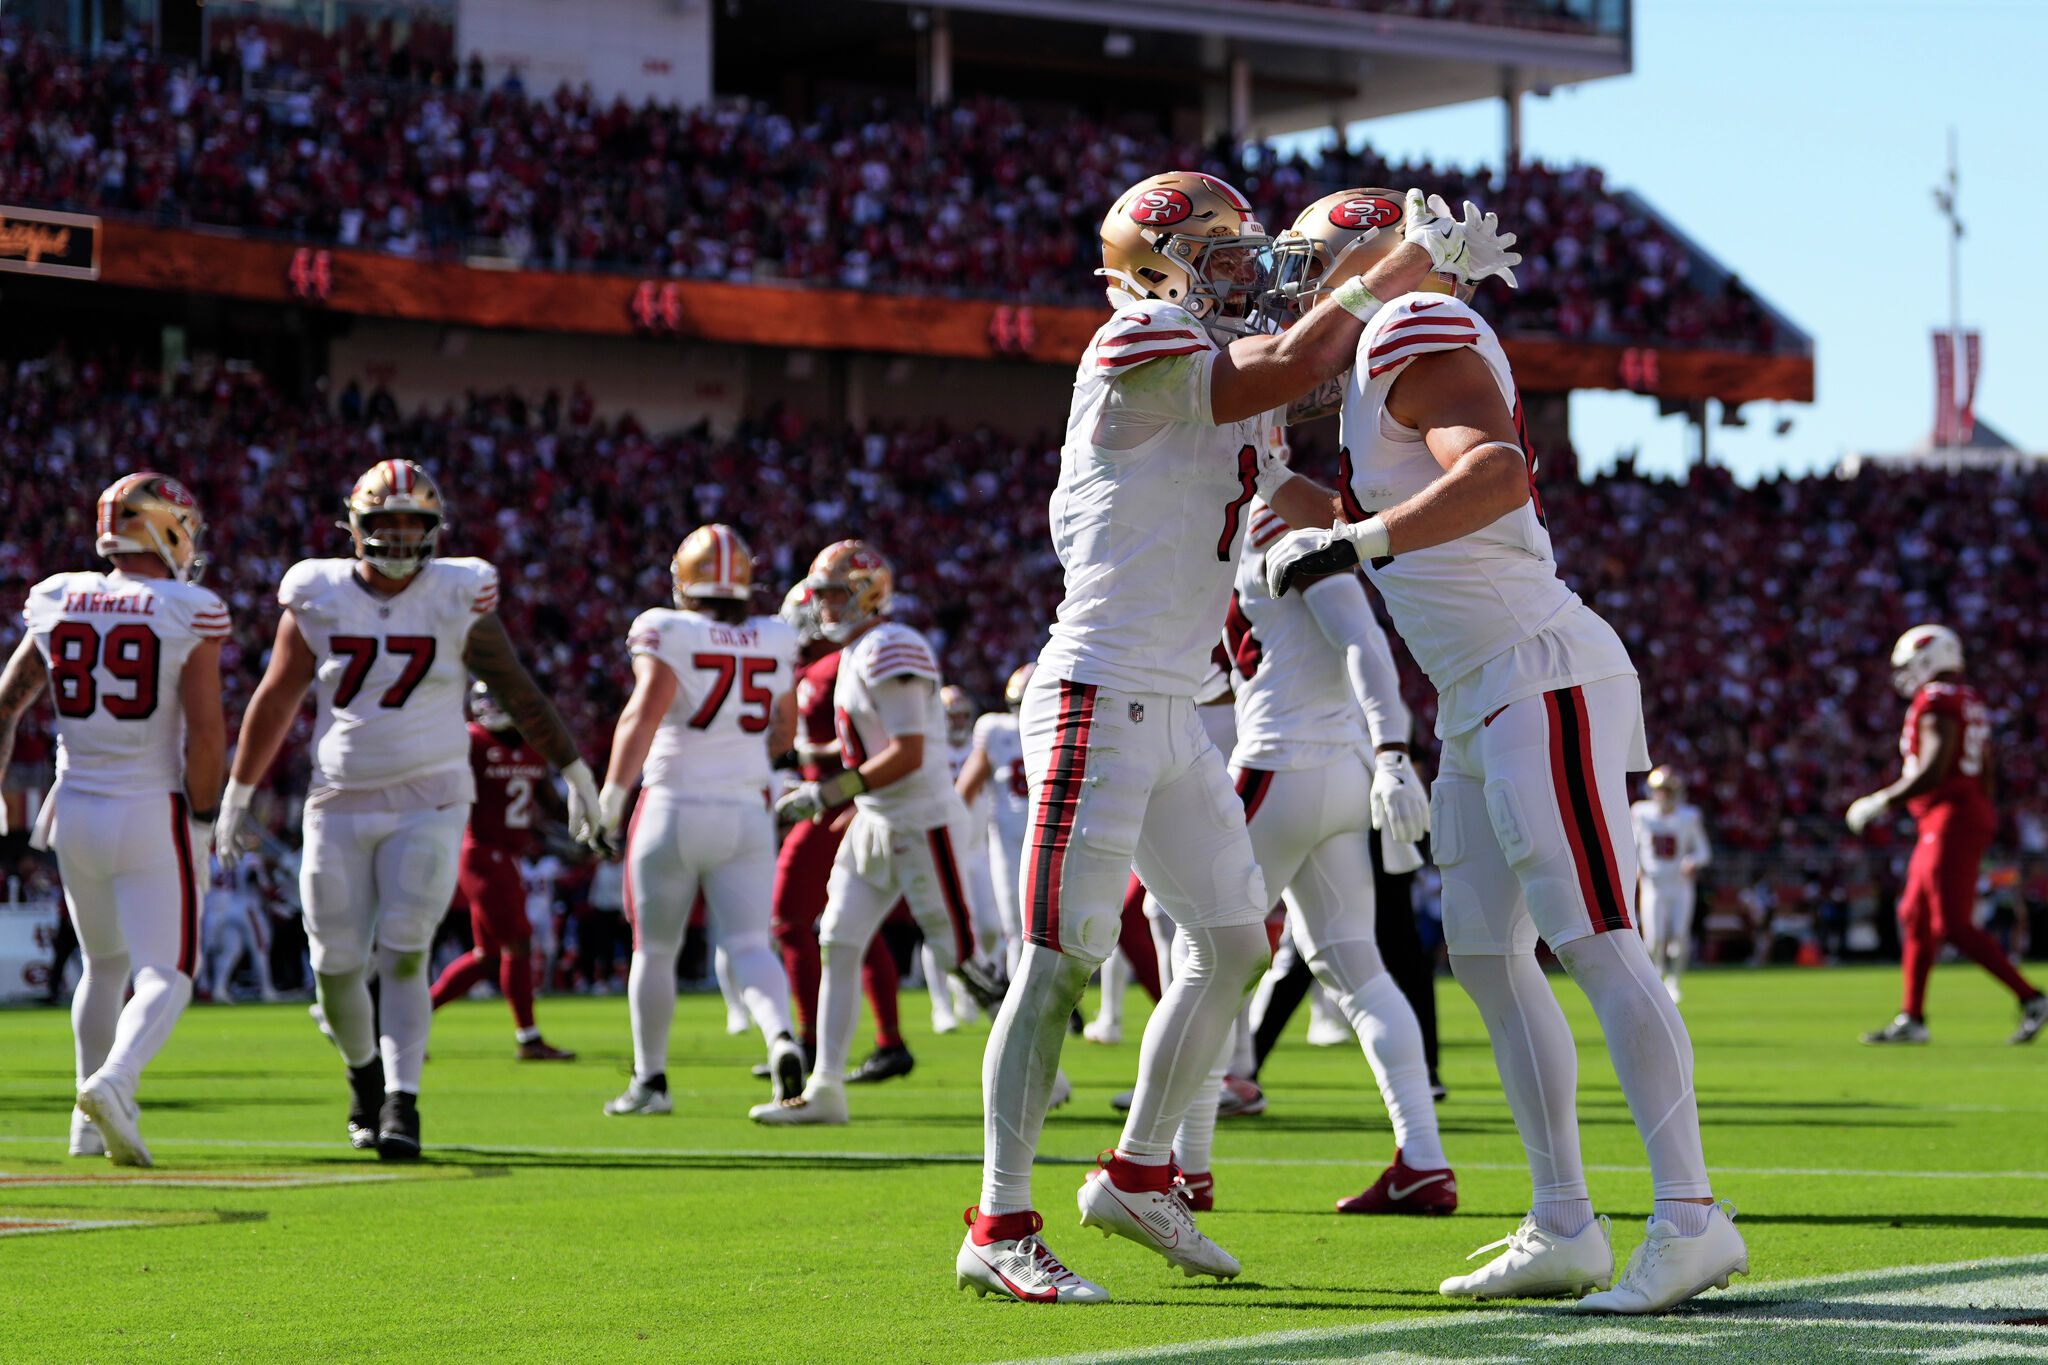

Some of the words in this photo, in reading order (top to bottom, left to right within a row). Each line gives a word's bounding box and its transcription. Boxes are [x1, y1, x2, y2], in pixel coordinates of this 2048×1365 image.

[63, 591, 155, 616] FARRELL
[49, 620, 161, 721] 89
[328, 635, 437, 709] 77
[687, 653, 778, 733] 75
[504, 777, 532, 830] 2
